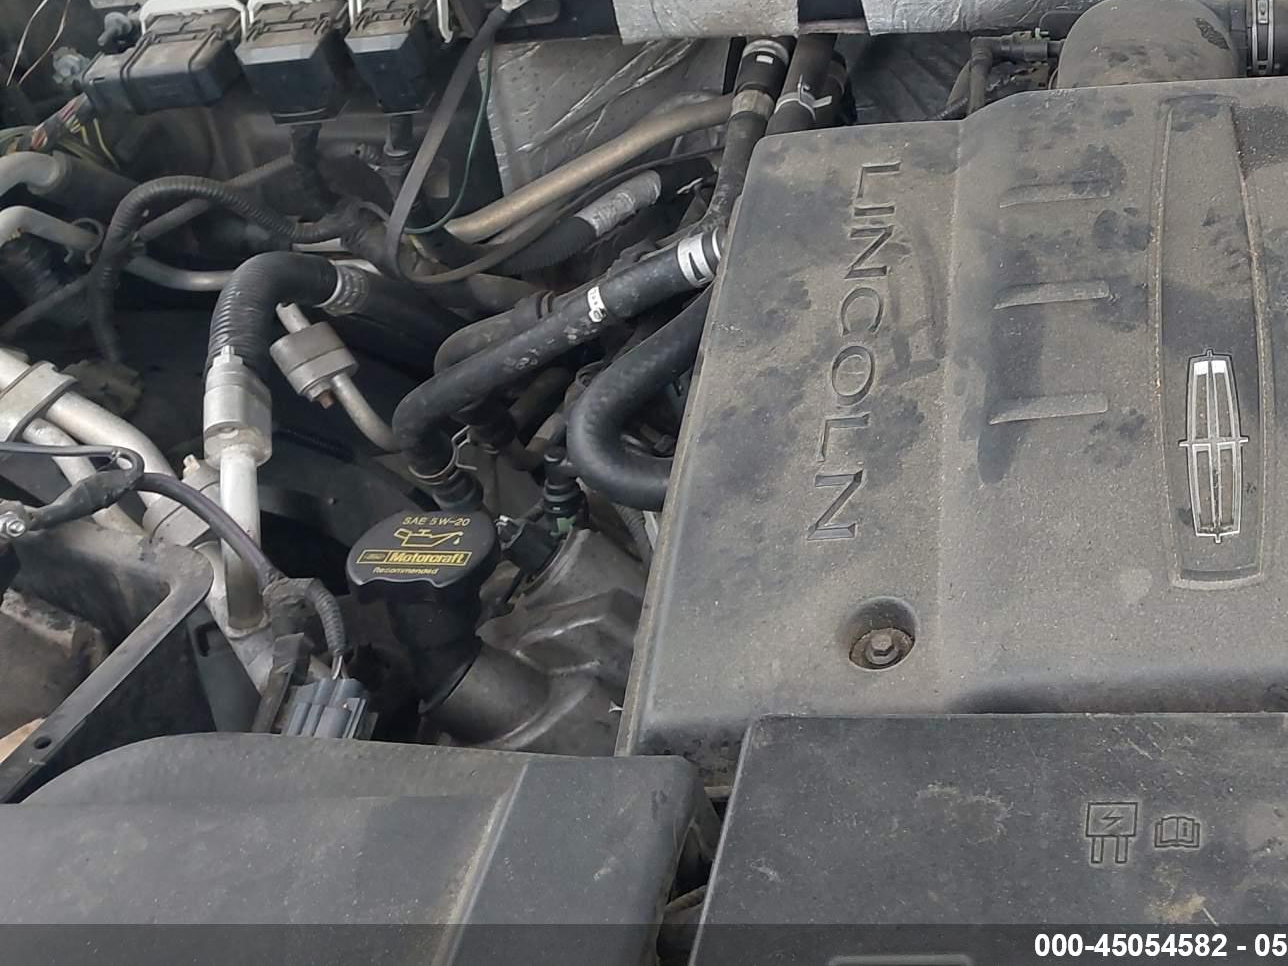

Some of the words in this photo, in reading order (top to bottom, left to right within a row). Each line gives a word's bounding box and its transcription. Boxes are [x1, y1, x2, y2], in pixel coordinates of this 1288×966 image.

[807, 162, 901, 540] LINCOLN
[402, 516, 427, 525] SAE
[429, 516, 471, 526] 5W-20
[389, 551, 465, 564] Motorcraft
[372, 566, 440, 575] Recommended
